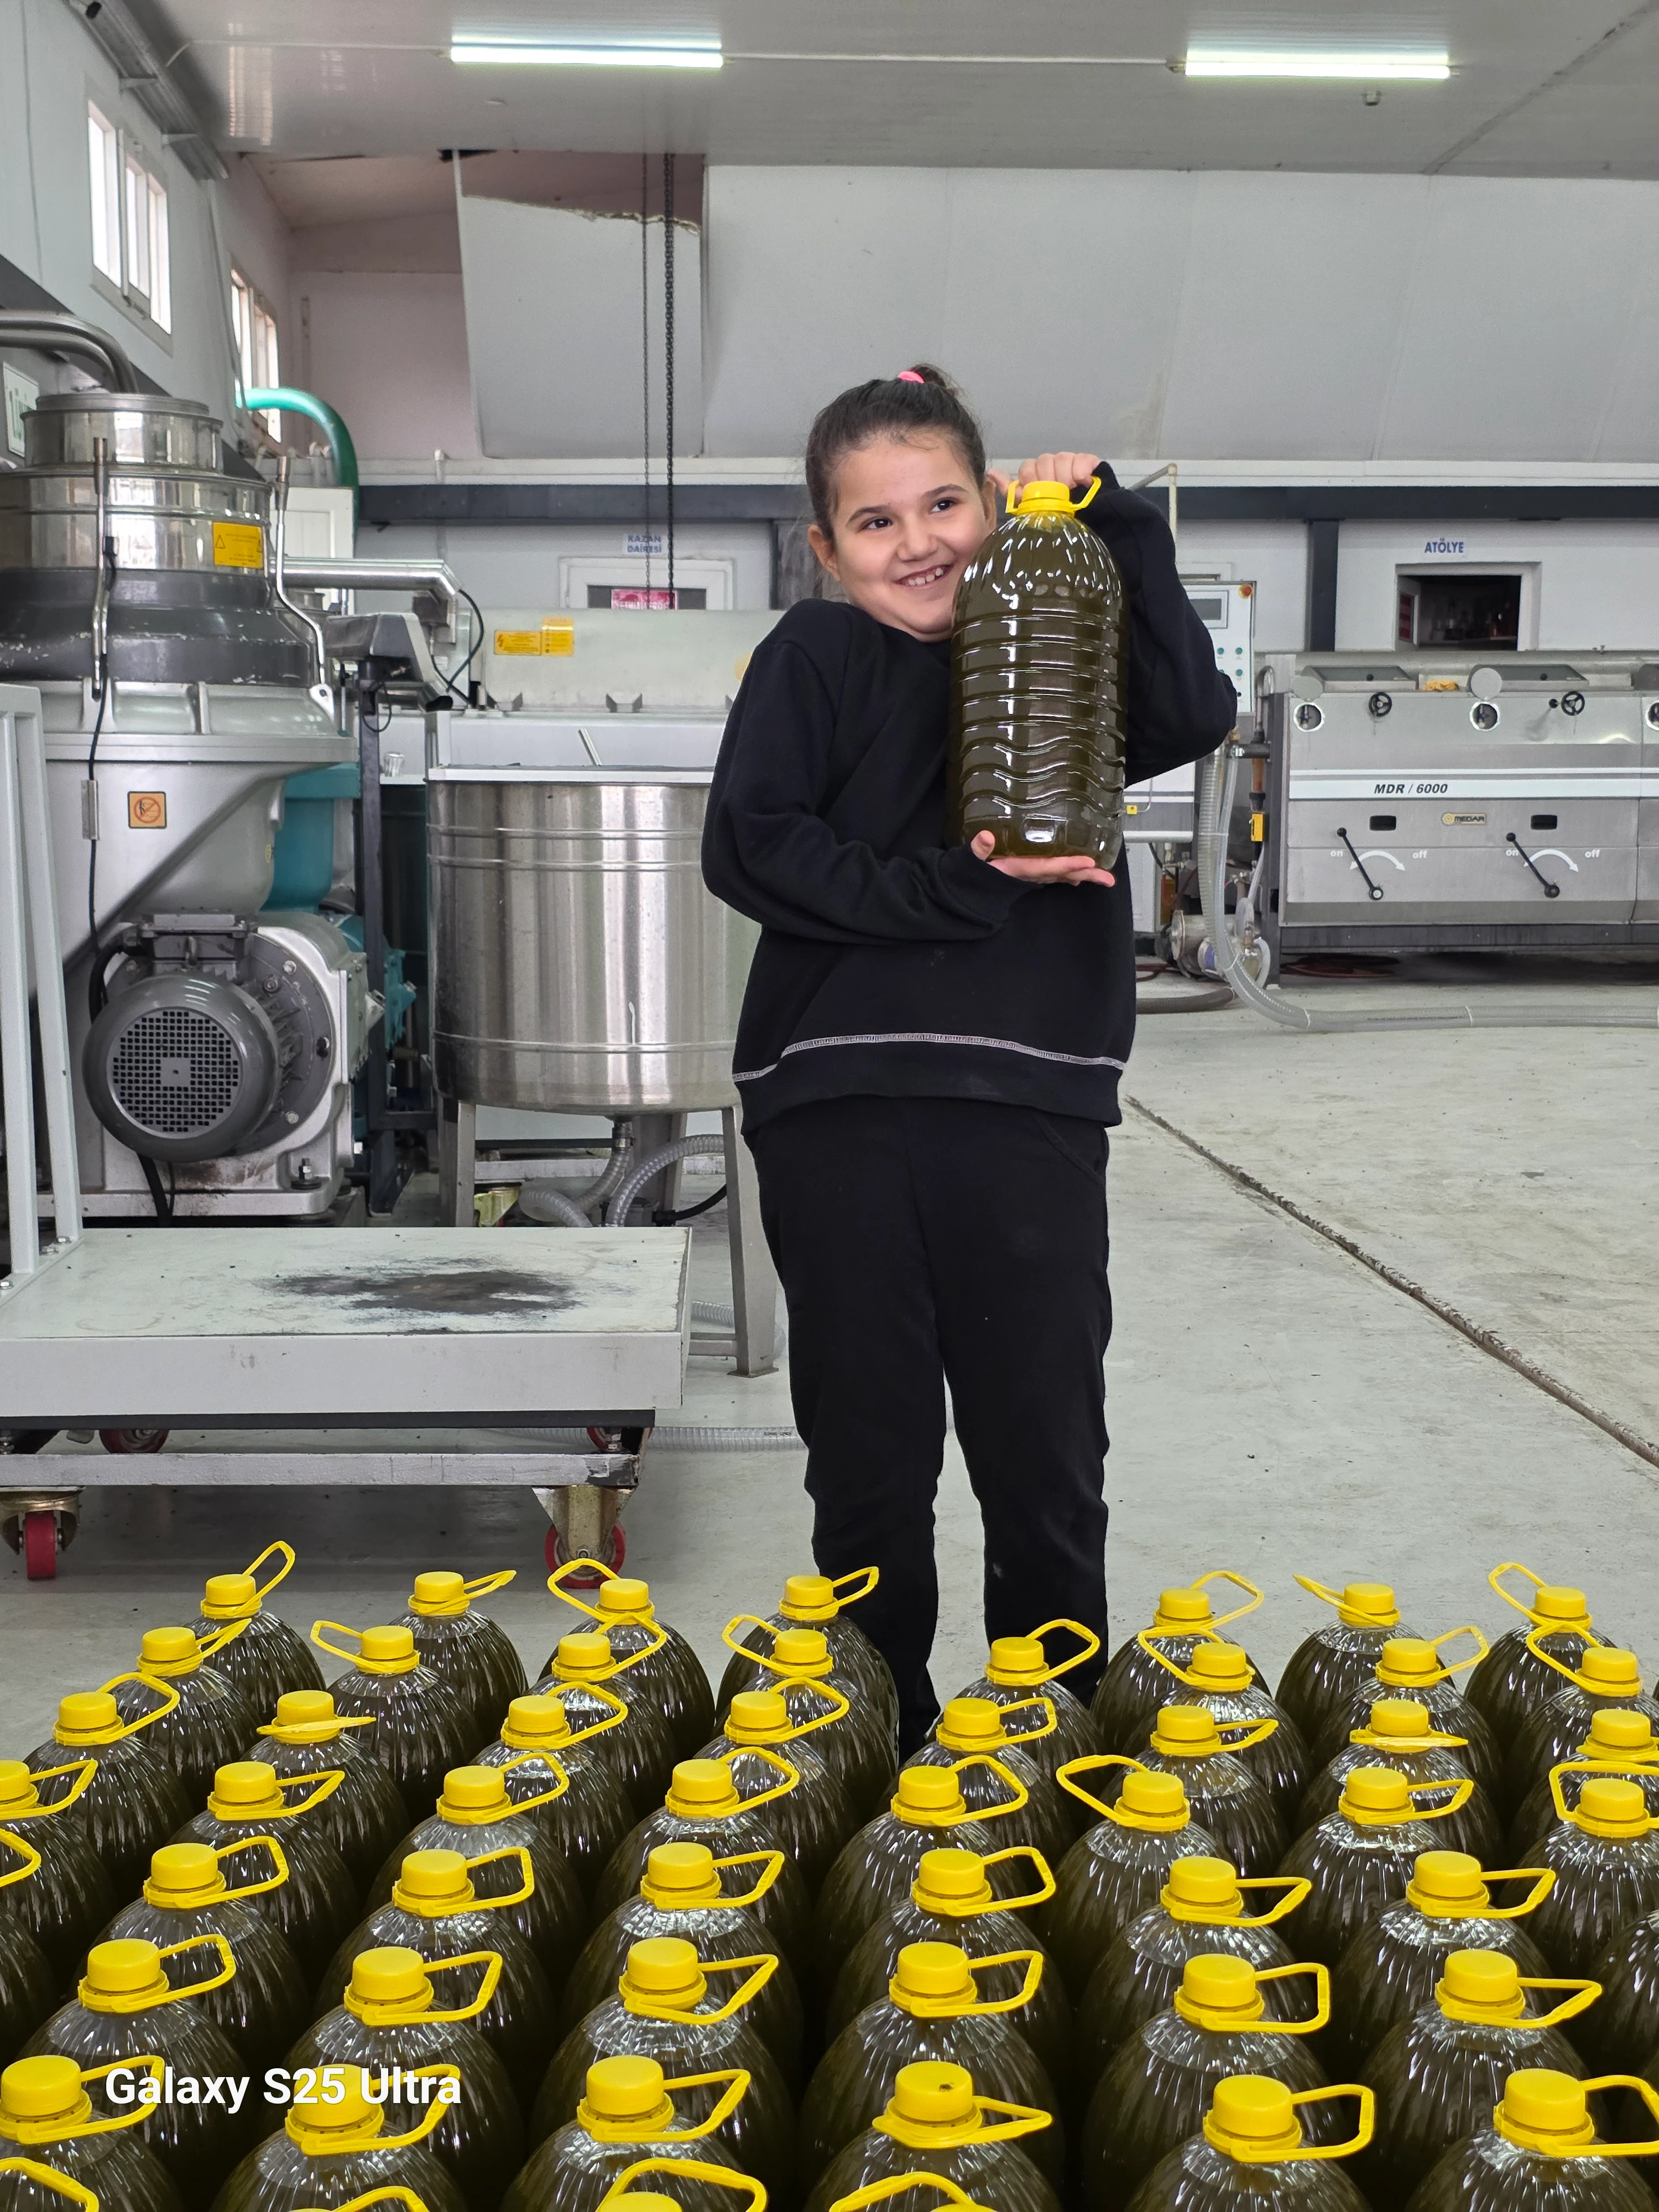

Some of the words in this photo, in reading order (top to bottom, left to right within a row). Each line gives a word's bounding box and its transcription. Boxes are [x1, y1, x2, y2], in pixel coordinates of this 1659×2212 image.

[1424, 538, 1464, 553] ATÖLYE
[1374, 784, 1405, 794] MDR
[1407, 784, 1413, 794] /
[1416, 784, 1448, 794] 6000
[1412, 850, 1427, 859] off
[1585, 849, 1600, 858] off
